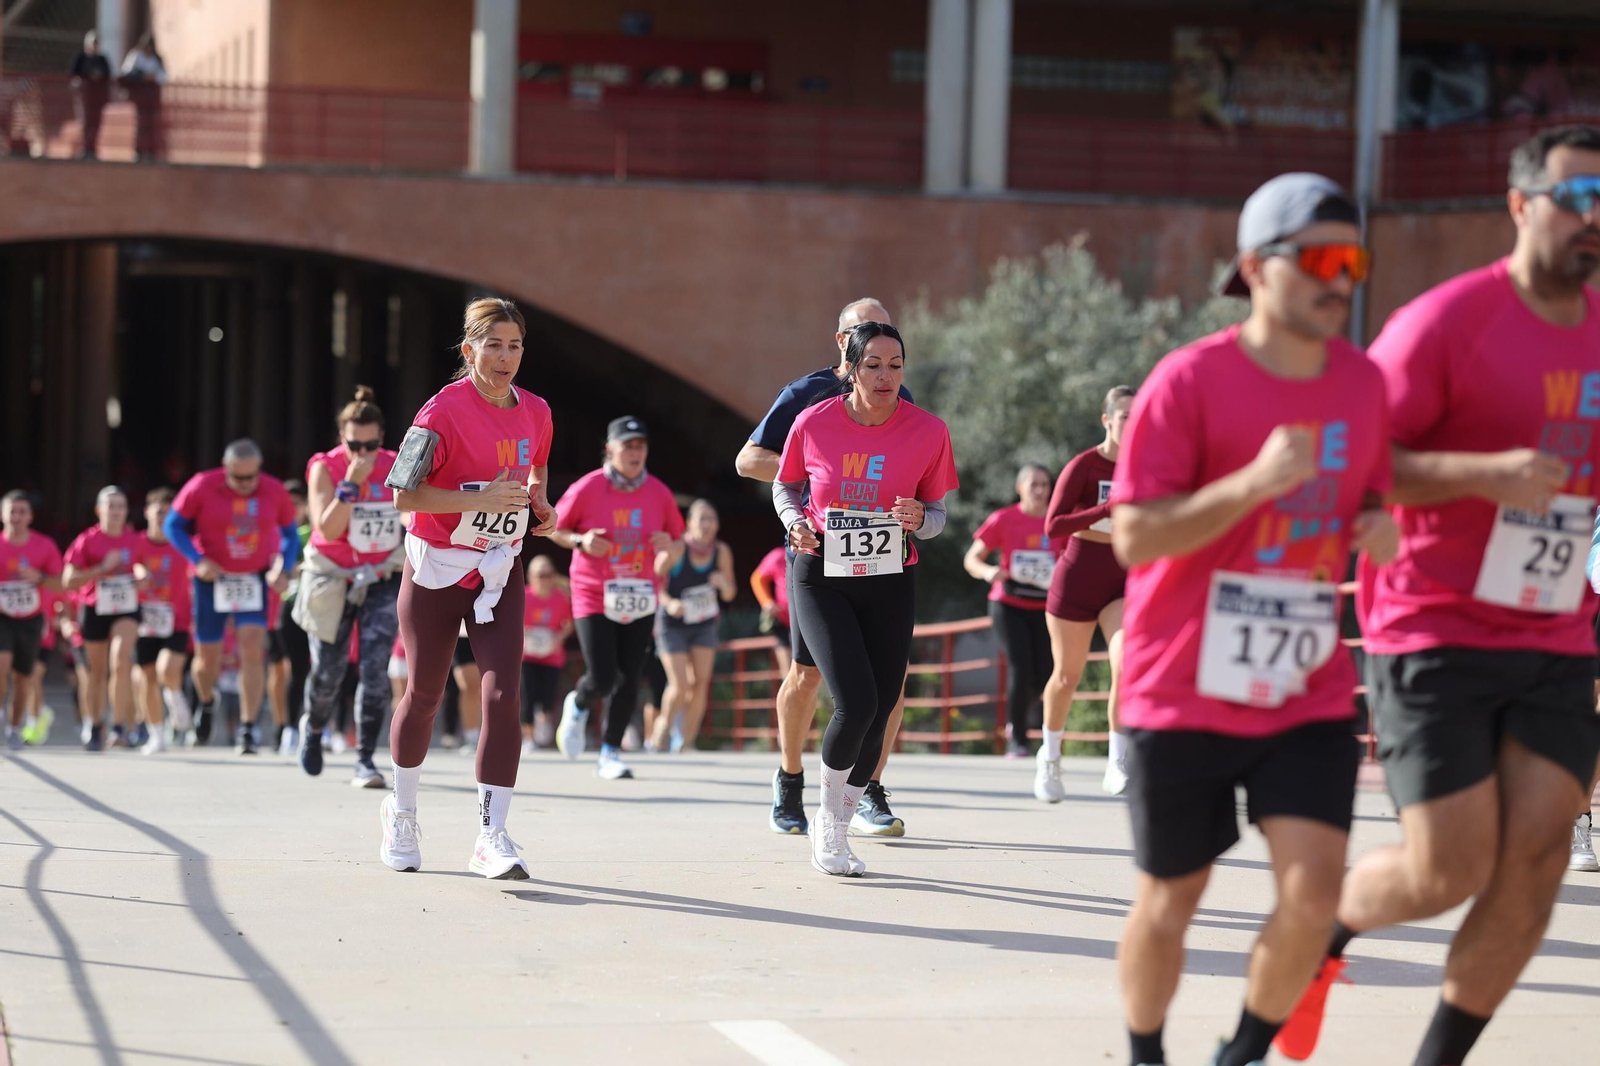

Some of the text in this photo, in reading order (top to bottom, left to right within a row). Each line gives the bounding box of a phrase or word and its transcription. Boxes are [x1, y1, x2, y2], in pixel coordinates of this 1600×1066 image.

[496, 439, 530, 466] WE
[842, 453, 885, 480] WE
[842, 482, 877, 502] RUN
[361, 520, 394, 538] 474
[472, 511, 518, 535] 426
[829, 518, 863, 529] UMA
[840, 530, 891, 557] 132
[1524, 535, 1573, 577] 29
[1231, 624, 1319, 669] 170
